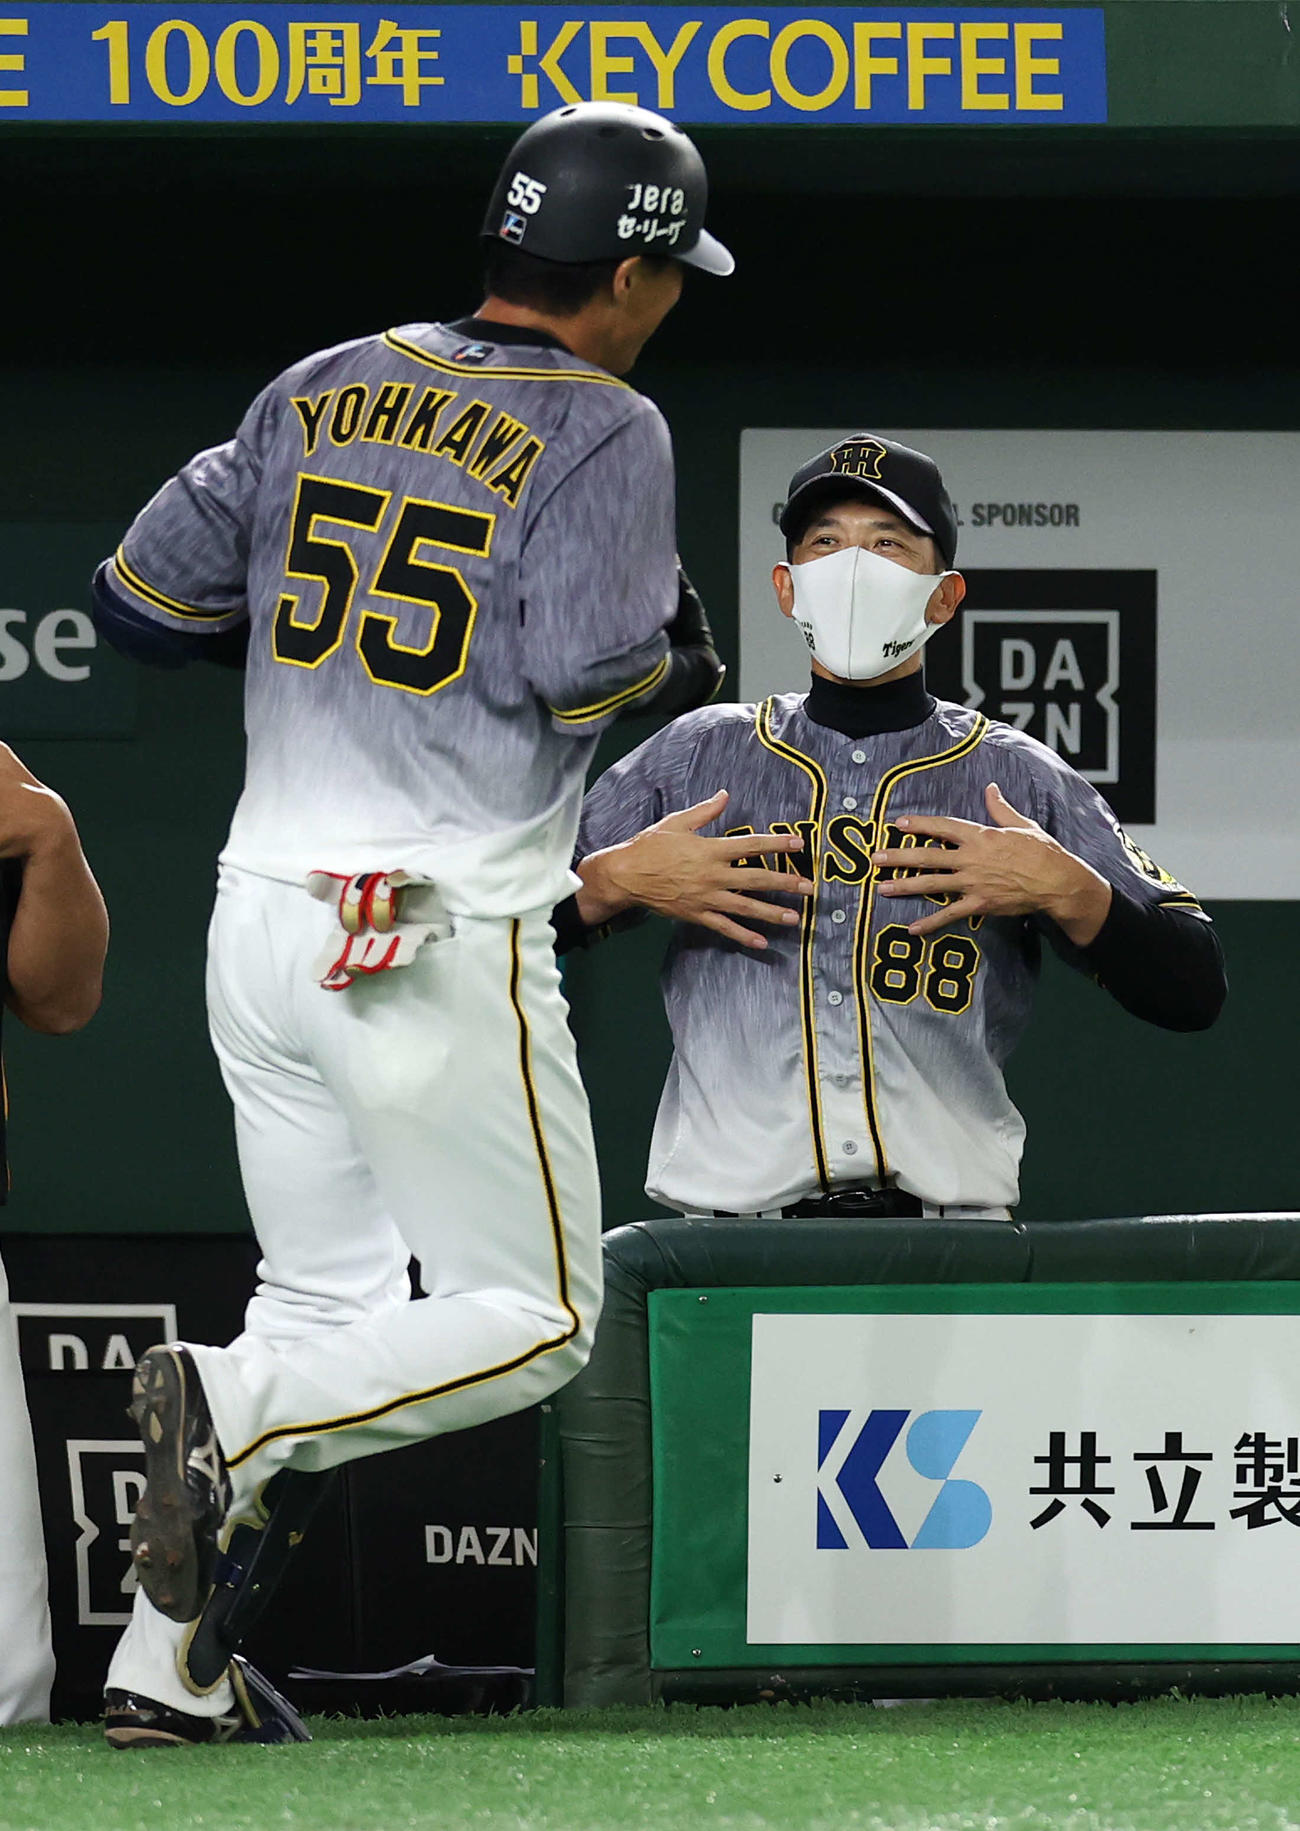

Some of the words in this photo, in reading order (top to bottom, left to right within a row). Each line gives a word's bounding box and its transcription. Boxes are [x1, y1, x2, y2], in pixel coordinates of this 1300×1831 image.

[92, 19, 445, 107] 100周年
[507, 171, 548, 215] 55
[290, 381, 546, 509] YOHKAWA
[972, 503, 1080, 527] SPONSOR
[272, 471, 497, 697] 55
[869, 923, 982, 1015] 88
[424, 1524, 538, 1567] DAZN
